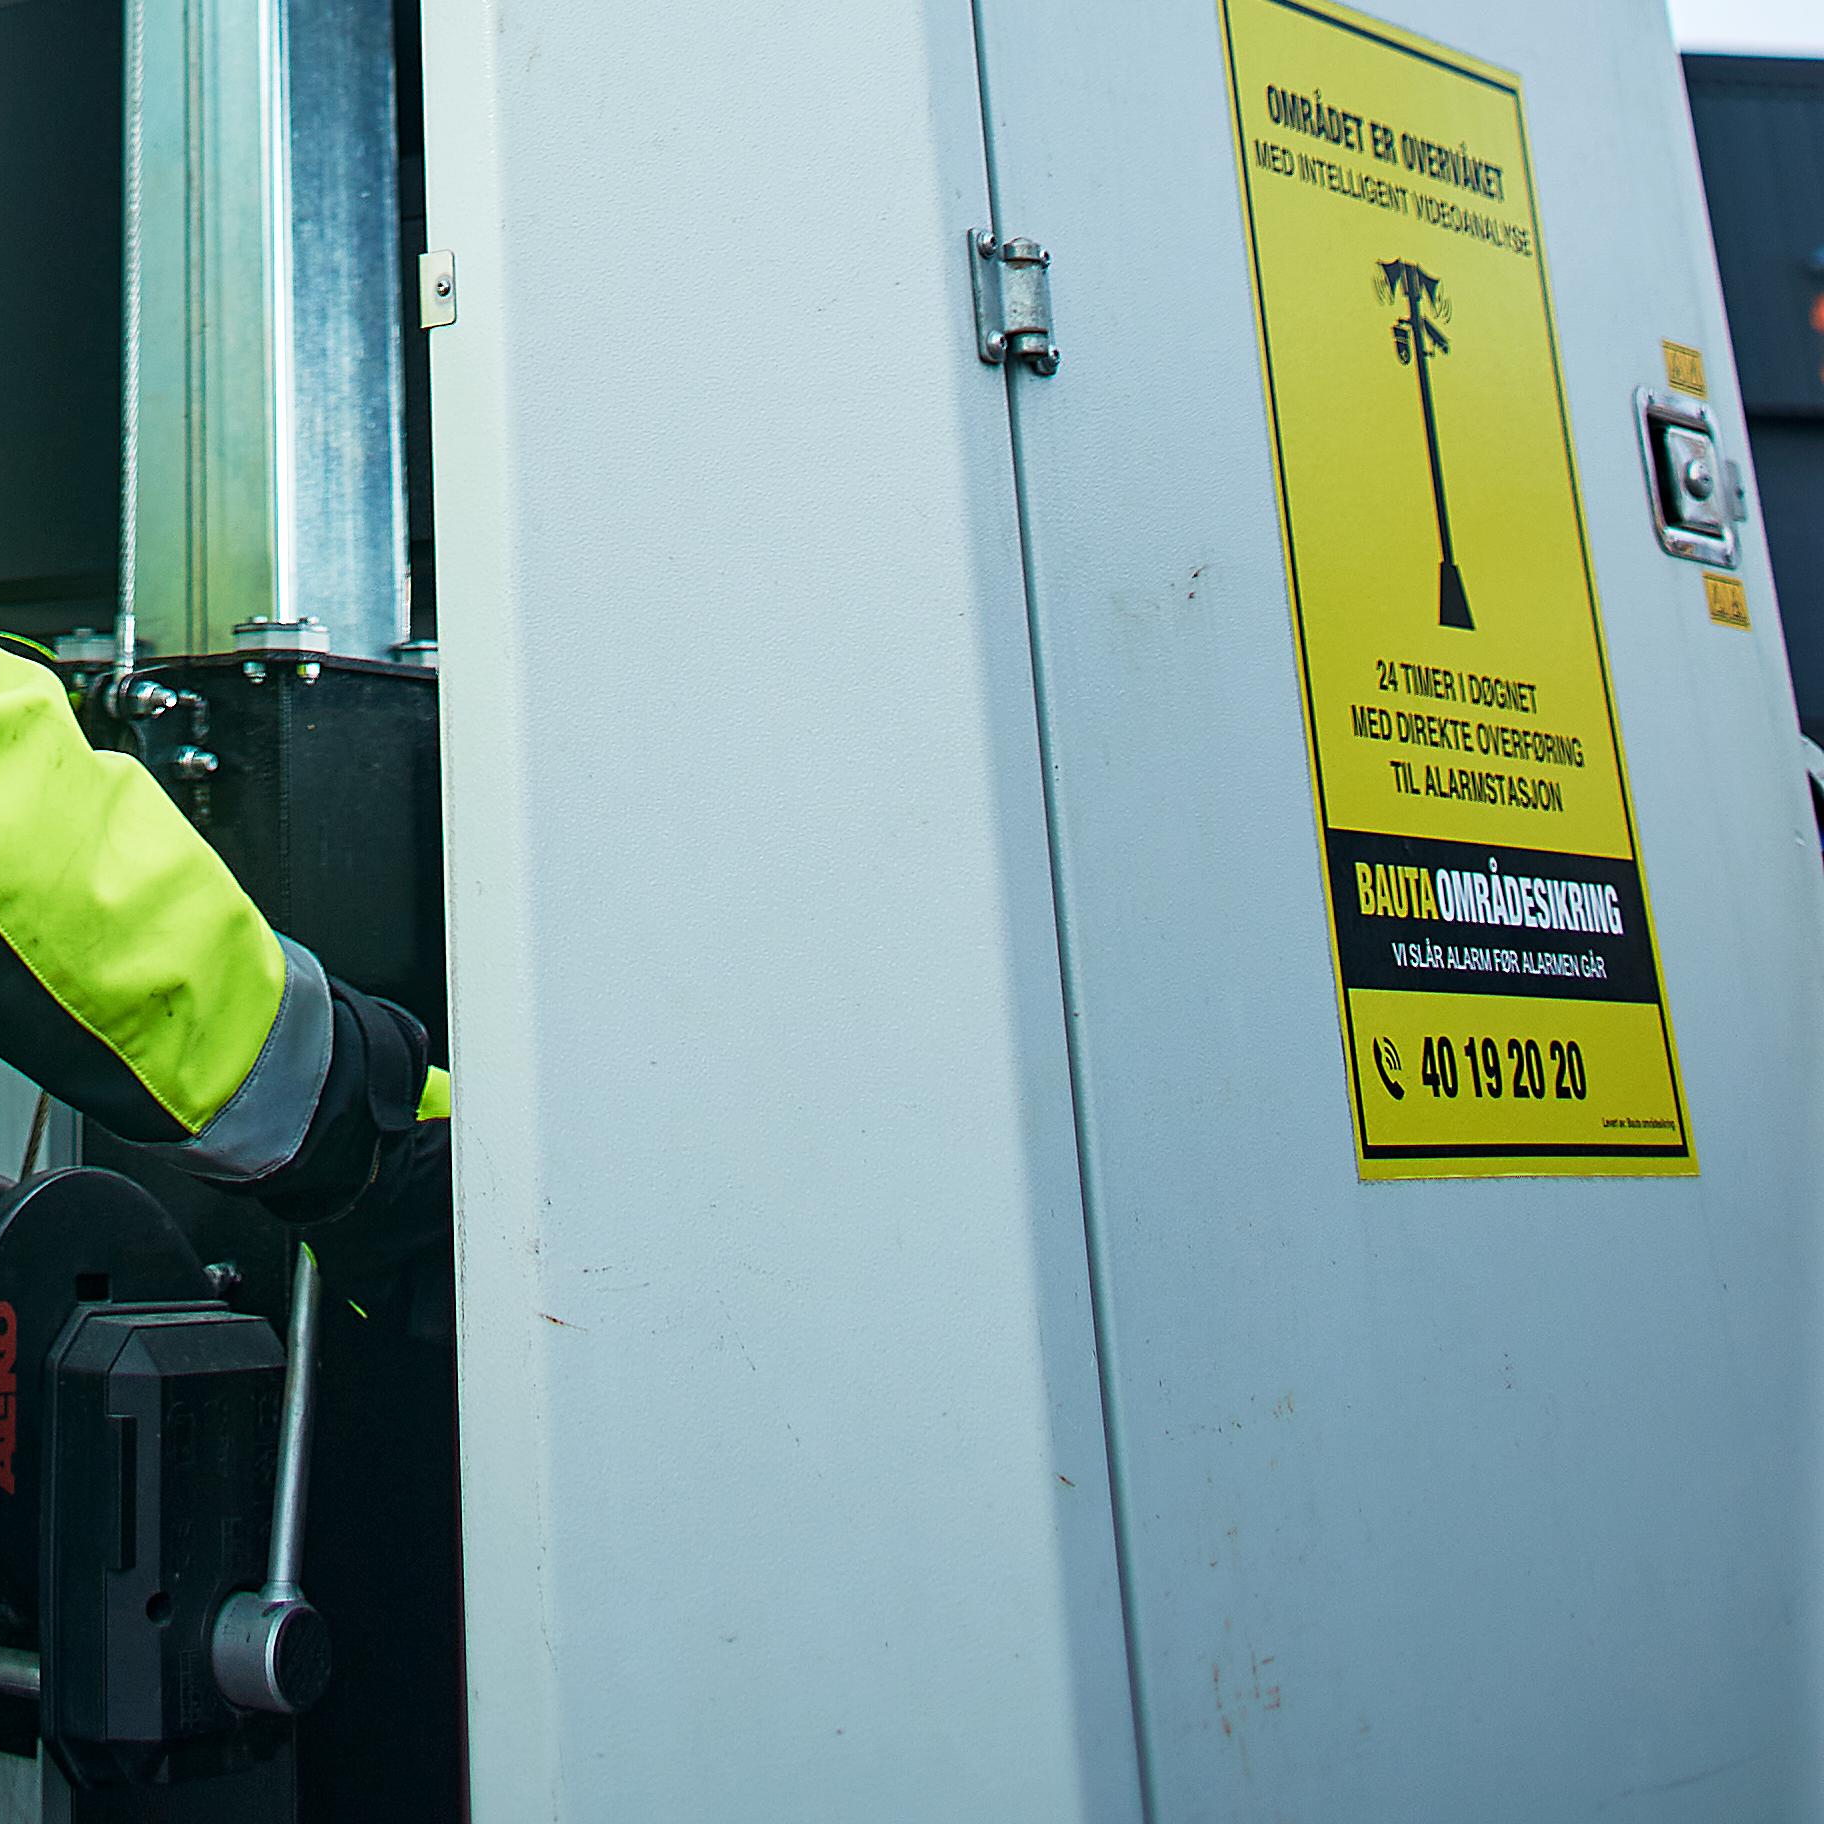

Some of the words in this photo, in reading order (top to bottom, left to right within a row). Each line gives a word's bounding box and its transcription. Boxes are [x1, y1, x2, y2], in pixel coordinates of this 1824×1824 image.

[1266, 82, 1364, 153] OMRÅDET
[1369, 119, 1398, 166] ER
[1401, 131, 1505, 204] OVERVÅKET
[1254, 138, 1295, 177] MED
[1298, 152, 1409, 216] INTELLIGENT
[1413, 191, 1532, 257] VIDEOANALYSE
[1376, 659, 1398, 692] 24
[1400, 662, 1457, 702] TIMER
[1458, 672, 1467, 703] I
[1468, 673, 1537, 714] DØGNET
[1350, 704, 1392, 741] MED
[1396, 711, 1474, 752] DIREKTE
[1476, 723, 1585, 768] OVERFØRING
[1389, 760, 1421, 795] TIL
[1425, 764, 1564, 813] ALARMSTASJON
[1391, 943, 1407, 967] VI
[1409, 938, 1445, 970] SLÅR
[1447, 945, 1492, 972] ALARM
[1494, 948, 1520, 974] FØR
[1522, 951, 1580, 978] ALARMEN
[1580, 950, 1608, 980] GÅR
[1422, 1036, 1459, 1099] 40
[1464, 1036, 1503, 1099] 19
[1507, 1037, 1545, 1100] 20
[1550, 1039, 1587, 1101] 20
